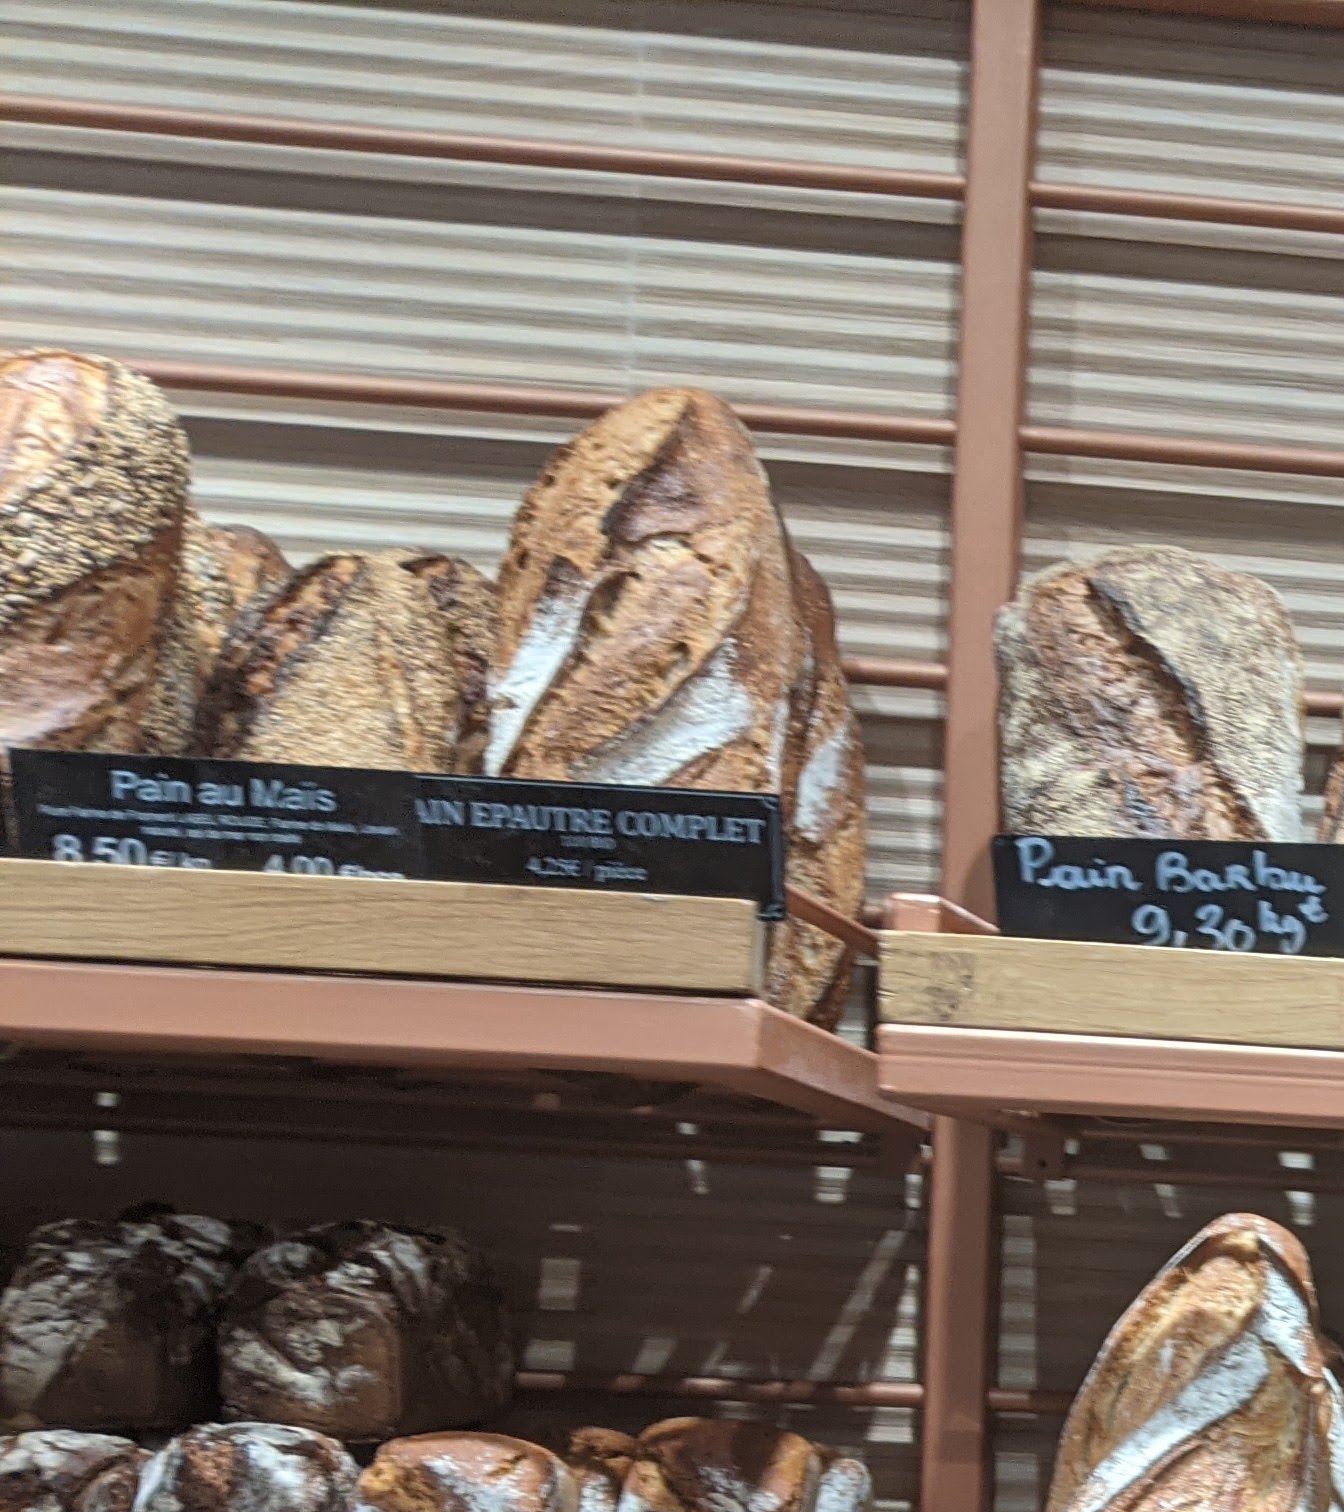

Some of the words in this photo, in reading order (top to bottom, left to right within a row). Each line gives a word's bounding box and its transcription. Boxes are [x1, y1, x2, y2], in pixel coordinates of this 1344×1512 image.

[110, 769, 193, 805] Pain
[196, 781, 245, 807] au
[469, 801, 614, 835] EPAUTRE
[615, 810, 767, 845] COMPLET
[1013, 836, 1143, 892] Pain
